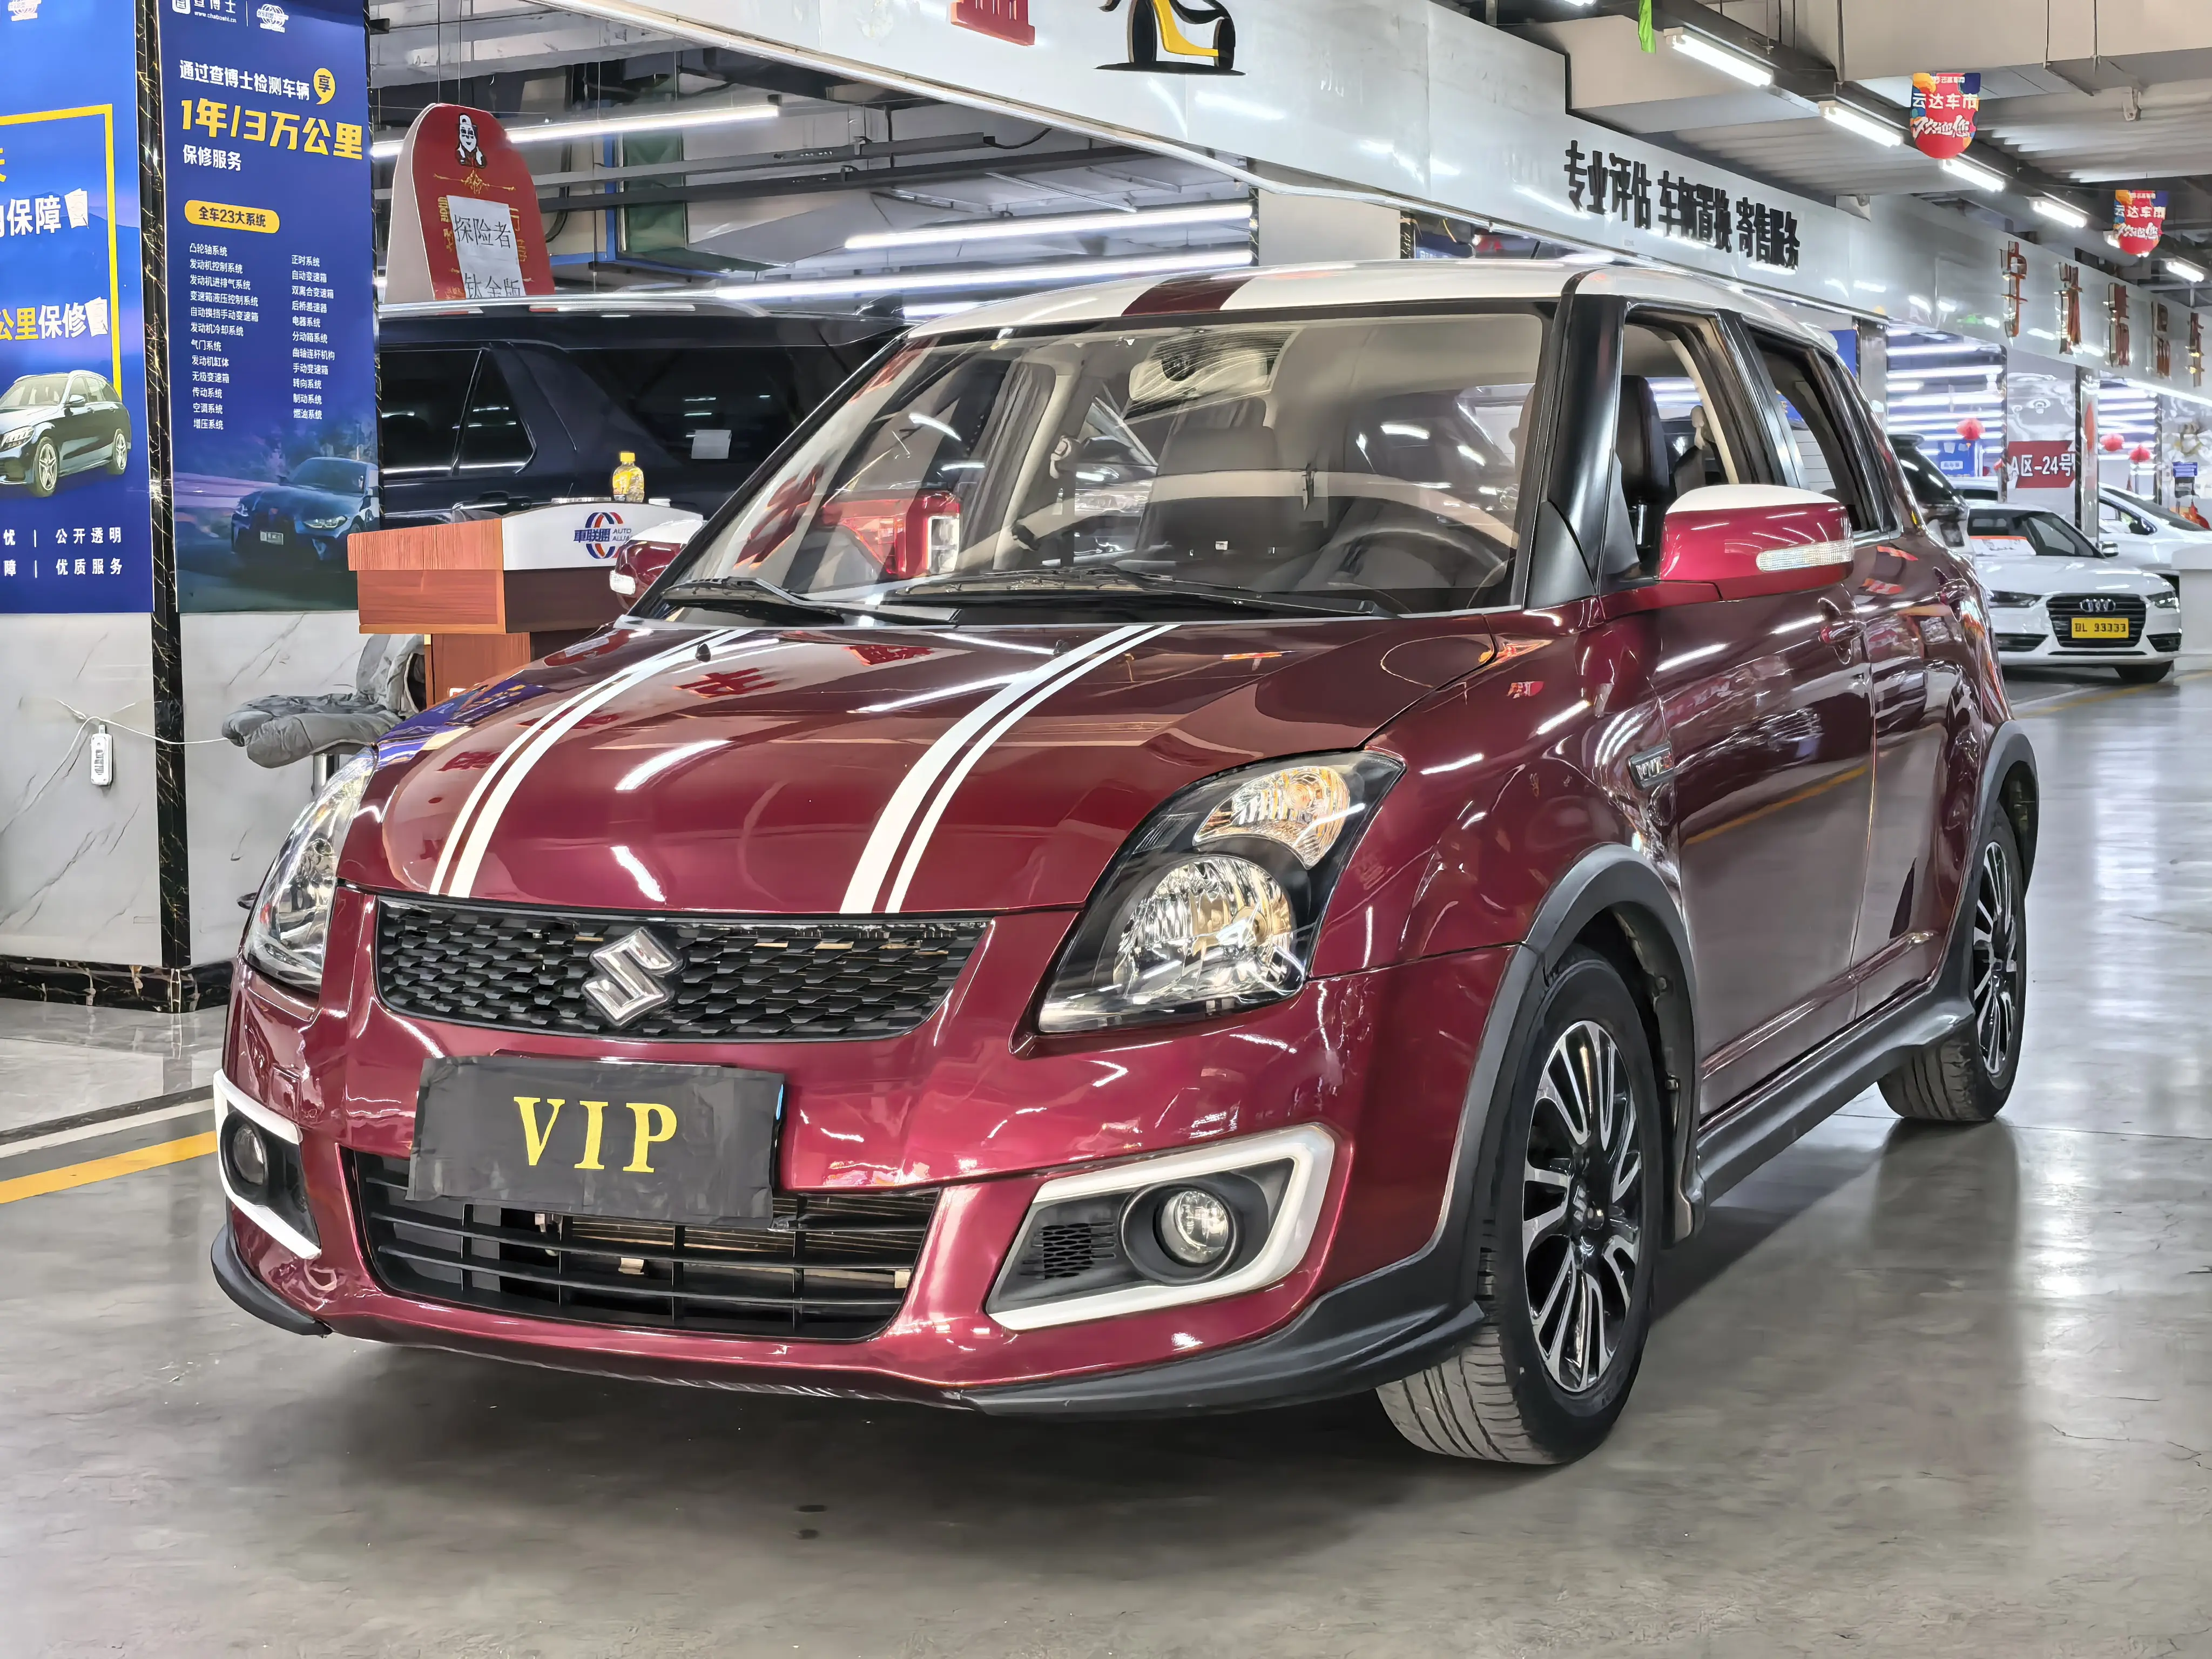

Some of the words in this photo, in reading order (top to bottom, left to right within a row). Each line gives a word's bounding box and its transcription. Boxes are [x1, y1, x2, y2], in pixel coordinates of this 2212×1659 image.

[180, 59, 310, 101] 通过查博士检测车辆
[318, 75, 331, 93] 享
[1912, 93, 1979, 110] 云达车市
[181, 97, 363, 160] 1年/3万公里
[1912, 114, 1970, 139] 欢迎您
[183, 144, 242, 171] 保修服务
[1564, 140, 1651, 230] 专业评估
[1736, 197, 1801, 272] 寄售服务
[0, 194, 62, 238] 保障
[198, 206, 266, 227] 全车23大系统
[455, 214, 511, 249] 探险者
[190, 242, 228, 257] 凸轮轴系统
[190, 258, 244, 274] 发动机控制系统
[291, 254, 320, 267] 正时系统
[190, 274, 251, 291] 发动机进排气系统
[292, 269, 327, 283] 自动变速箱
[291, 285, 334, 299] 双离合变速箱
[292, 300, 327, 313] 后桥差速器
[190, 322, 244, 336] 发动机冷却系统
[292, 315, 321, 328] 电器系统
[292, 331, 328, 344] 分动箱系统
[191, 339, 222, 352] 气门系统
[192, 355, 230, 367] 发动机缸体
[293, 362, 328, 375] 手动变速箱
[293, 378, 322, 389] 转向系统
[192, 387, 222, 399] 传动系统
[293, 393, 322, 405] 制动系统
[193, 402, 223, 414] 空调系统
[193, 418, 224, 430] 增压系统
[2009, 453, 2073, 477] A区-24号
[56, 527, 122, 544] 公开透明
[56, 557, 123, 575] 优质服务
[513, 1096, 678, 1173] VIP
